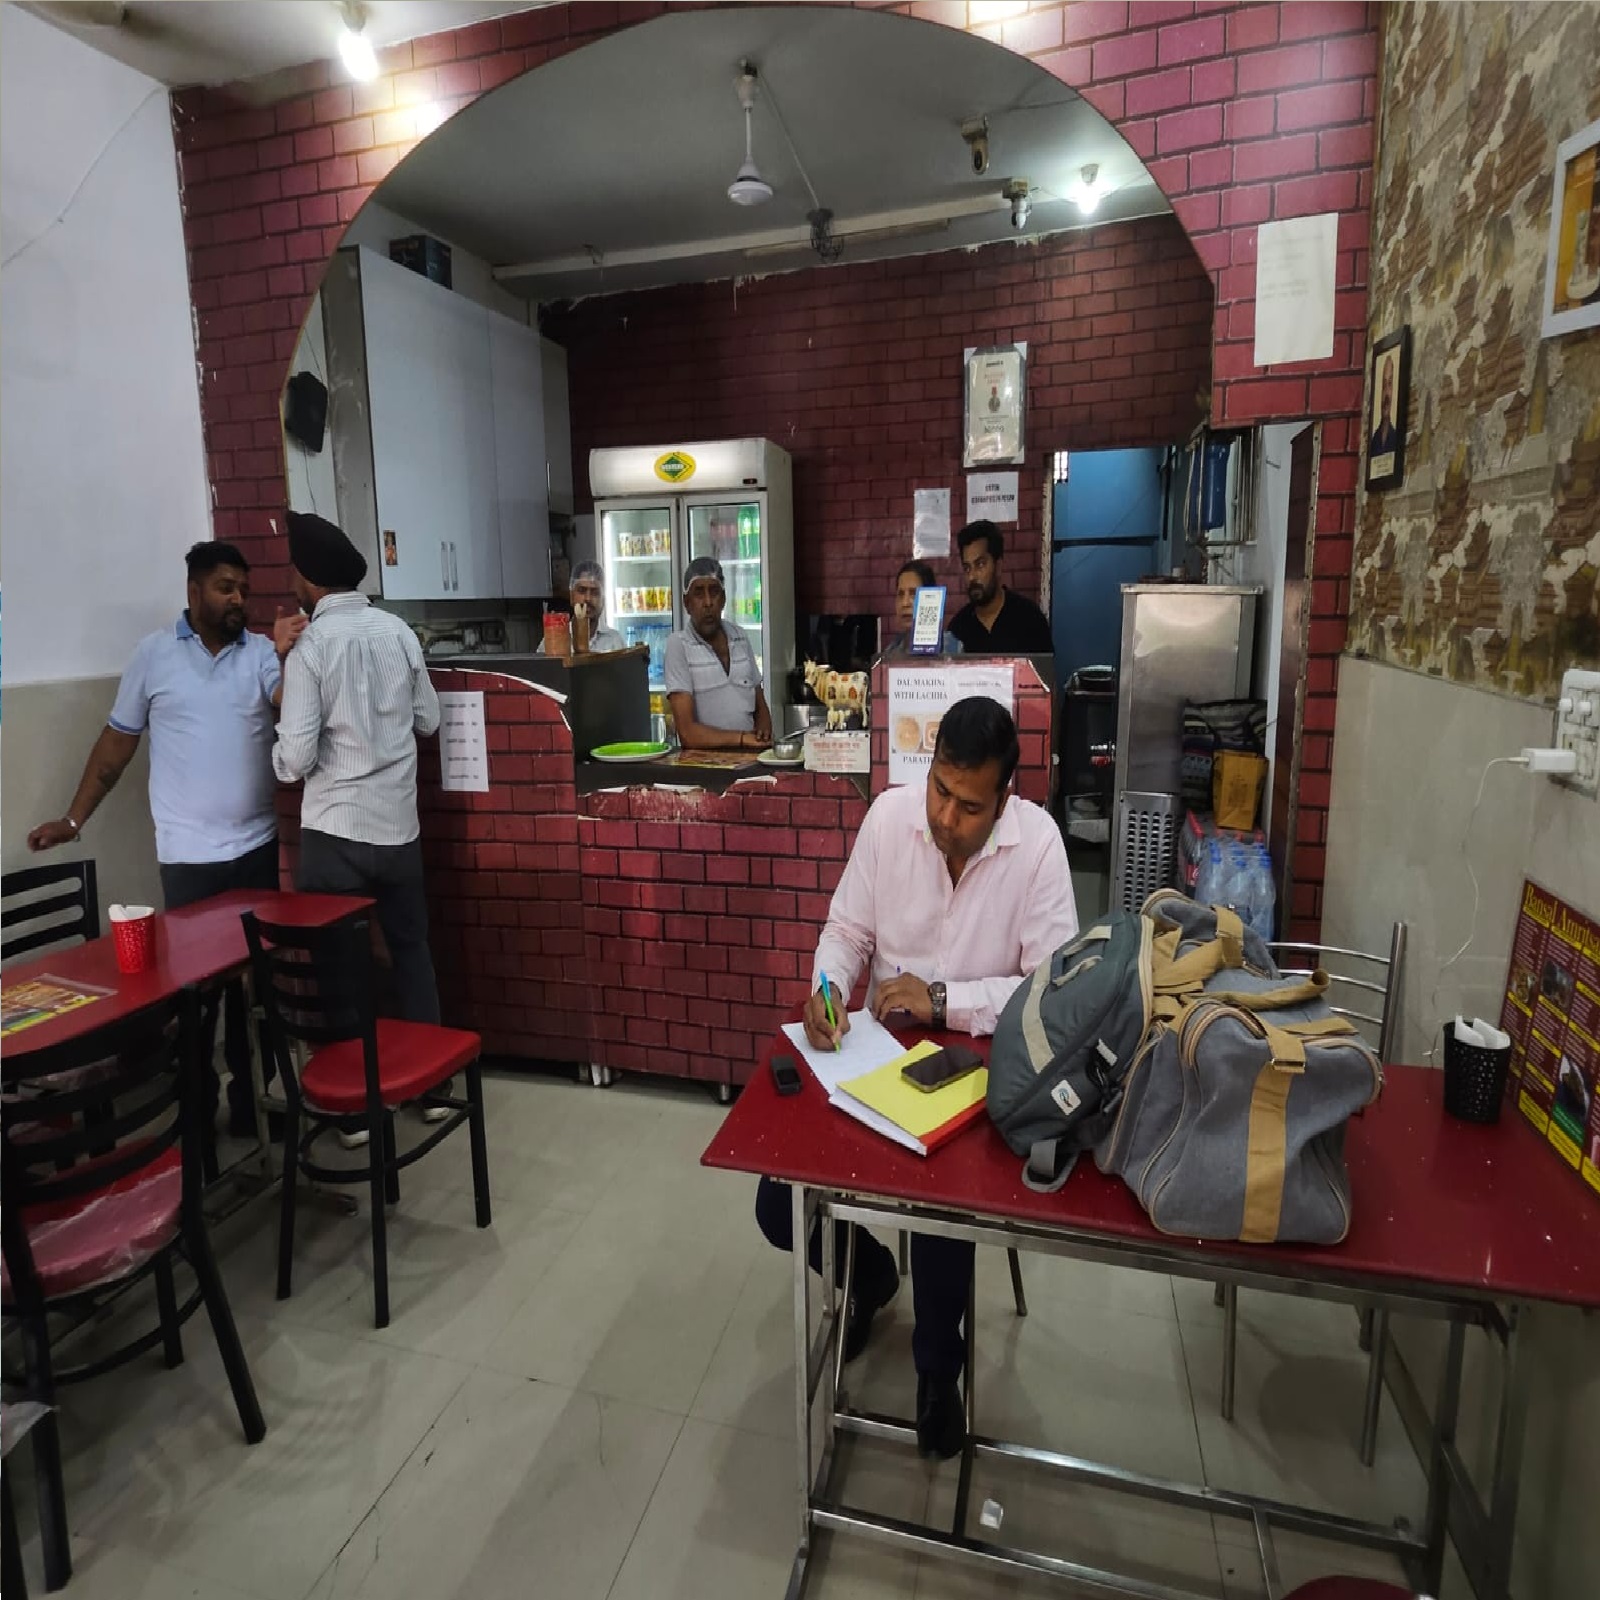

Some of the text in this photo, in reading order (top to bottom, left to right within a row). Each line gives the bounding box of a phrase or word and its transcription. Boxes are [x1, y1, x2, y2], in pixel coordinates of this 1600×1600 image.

[896, 678, 911, 686] DAL
[894, 691, 914, 700] WITH
[903, 756, 933, 765] PARATH
[1556, 907, 1600, 954] Amritsa
